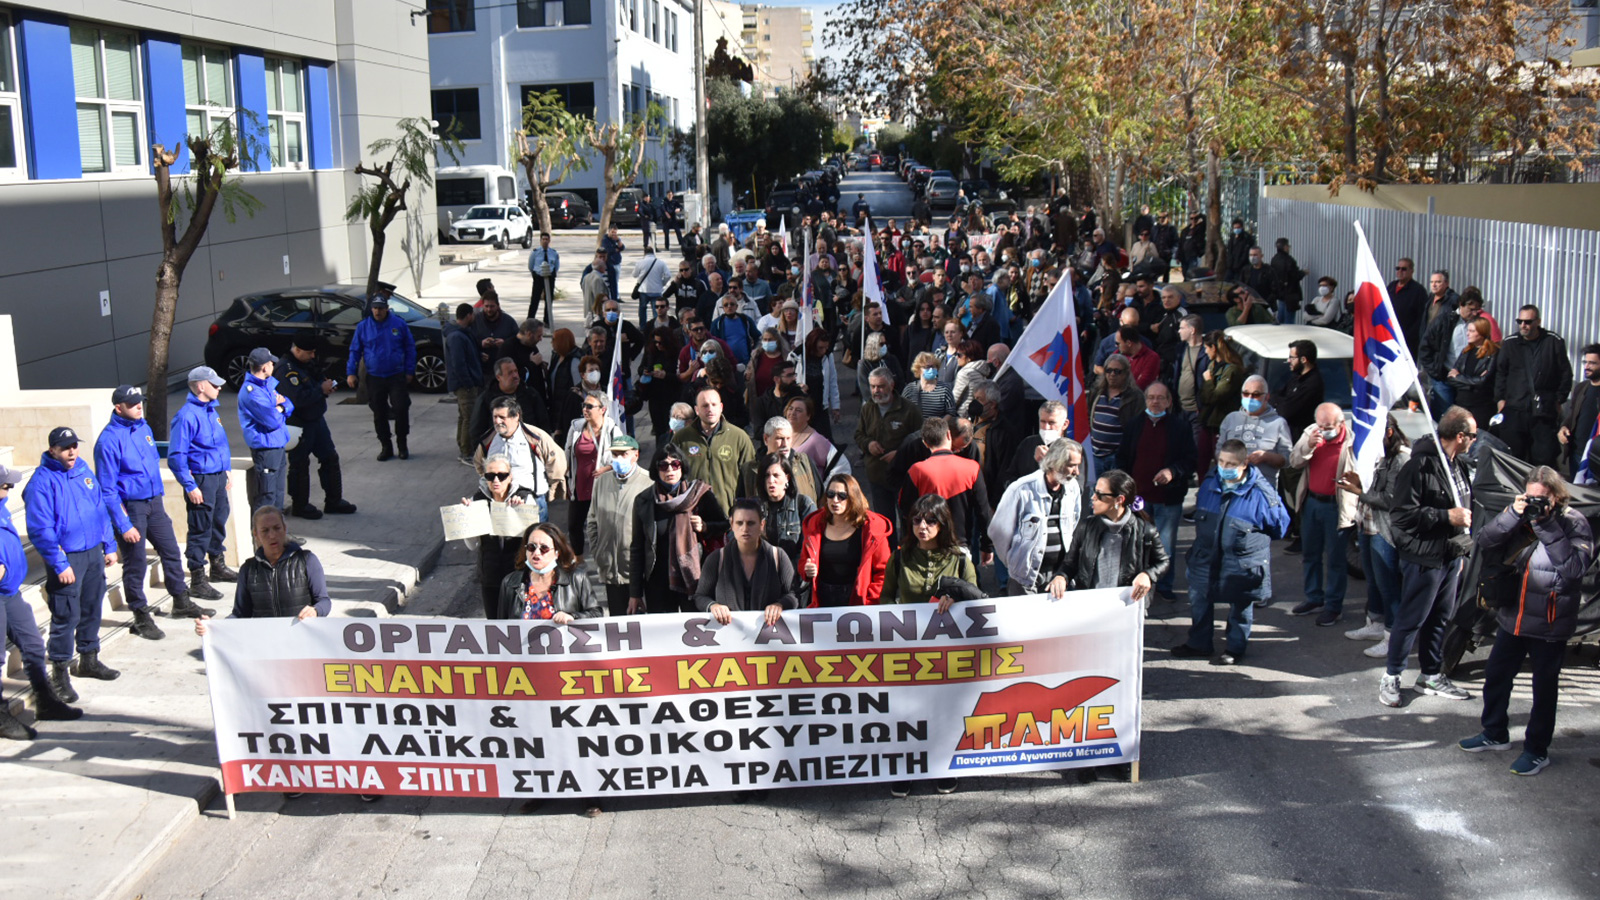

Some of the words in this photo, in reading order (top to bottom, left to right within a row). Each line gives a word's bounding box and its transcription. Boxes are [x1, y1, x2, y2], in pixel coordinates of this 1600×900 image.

[343, 621, 642, 655] ΟΡΓΑΝΩΣΗ
[681, 618, 721, 647] &
[754, 605, 999, 645] ΑΓΩΝΑΣ
[323, 663, 538, 696] ΕΝΑΝΤΙΑ
[560, 666, 652, 696] ΣΤΙΣ
[676, 644, 1024, 690] ΚΑΤΑΣΧΕΣΕΙΣ
[267, 702, 457, 727] ΣΠΙΤΙΩΝ
[489, 705, 519, 729] &
[551, 691, 889, 729] ΚΑΤΑΘΕΣΕΩΝ
[238, 731, 331, 755] ΤΩΝ
[361, 729, 545, 759] ΛΑΪΚΩΝ
[578, 720, 928, 758] ΝΟΙΚΟΚΥΡΙΩΝ
[956, 752, 1018, 766] Πανεργατικό
[1019, 749, 1074, 763] Αγωνιστικό
[1075, 746, 1115, 758] Μέτωπο
[241, 763, 385, 790] ΚΑΝΕΝΑ
[399, 766, 487, 793] ΣΠΙΤΙ
[513, 769, 582, 794] ΣΤΑ
[598, 764, 709, 792] ΧΕΡΙΑ
[724, 751, 929, 785] ΤΡΑΠΕΖΙΤΗ
